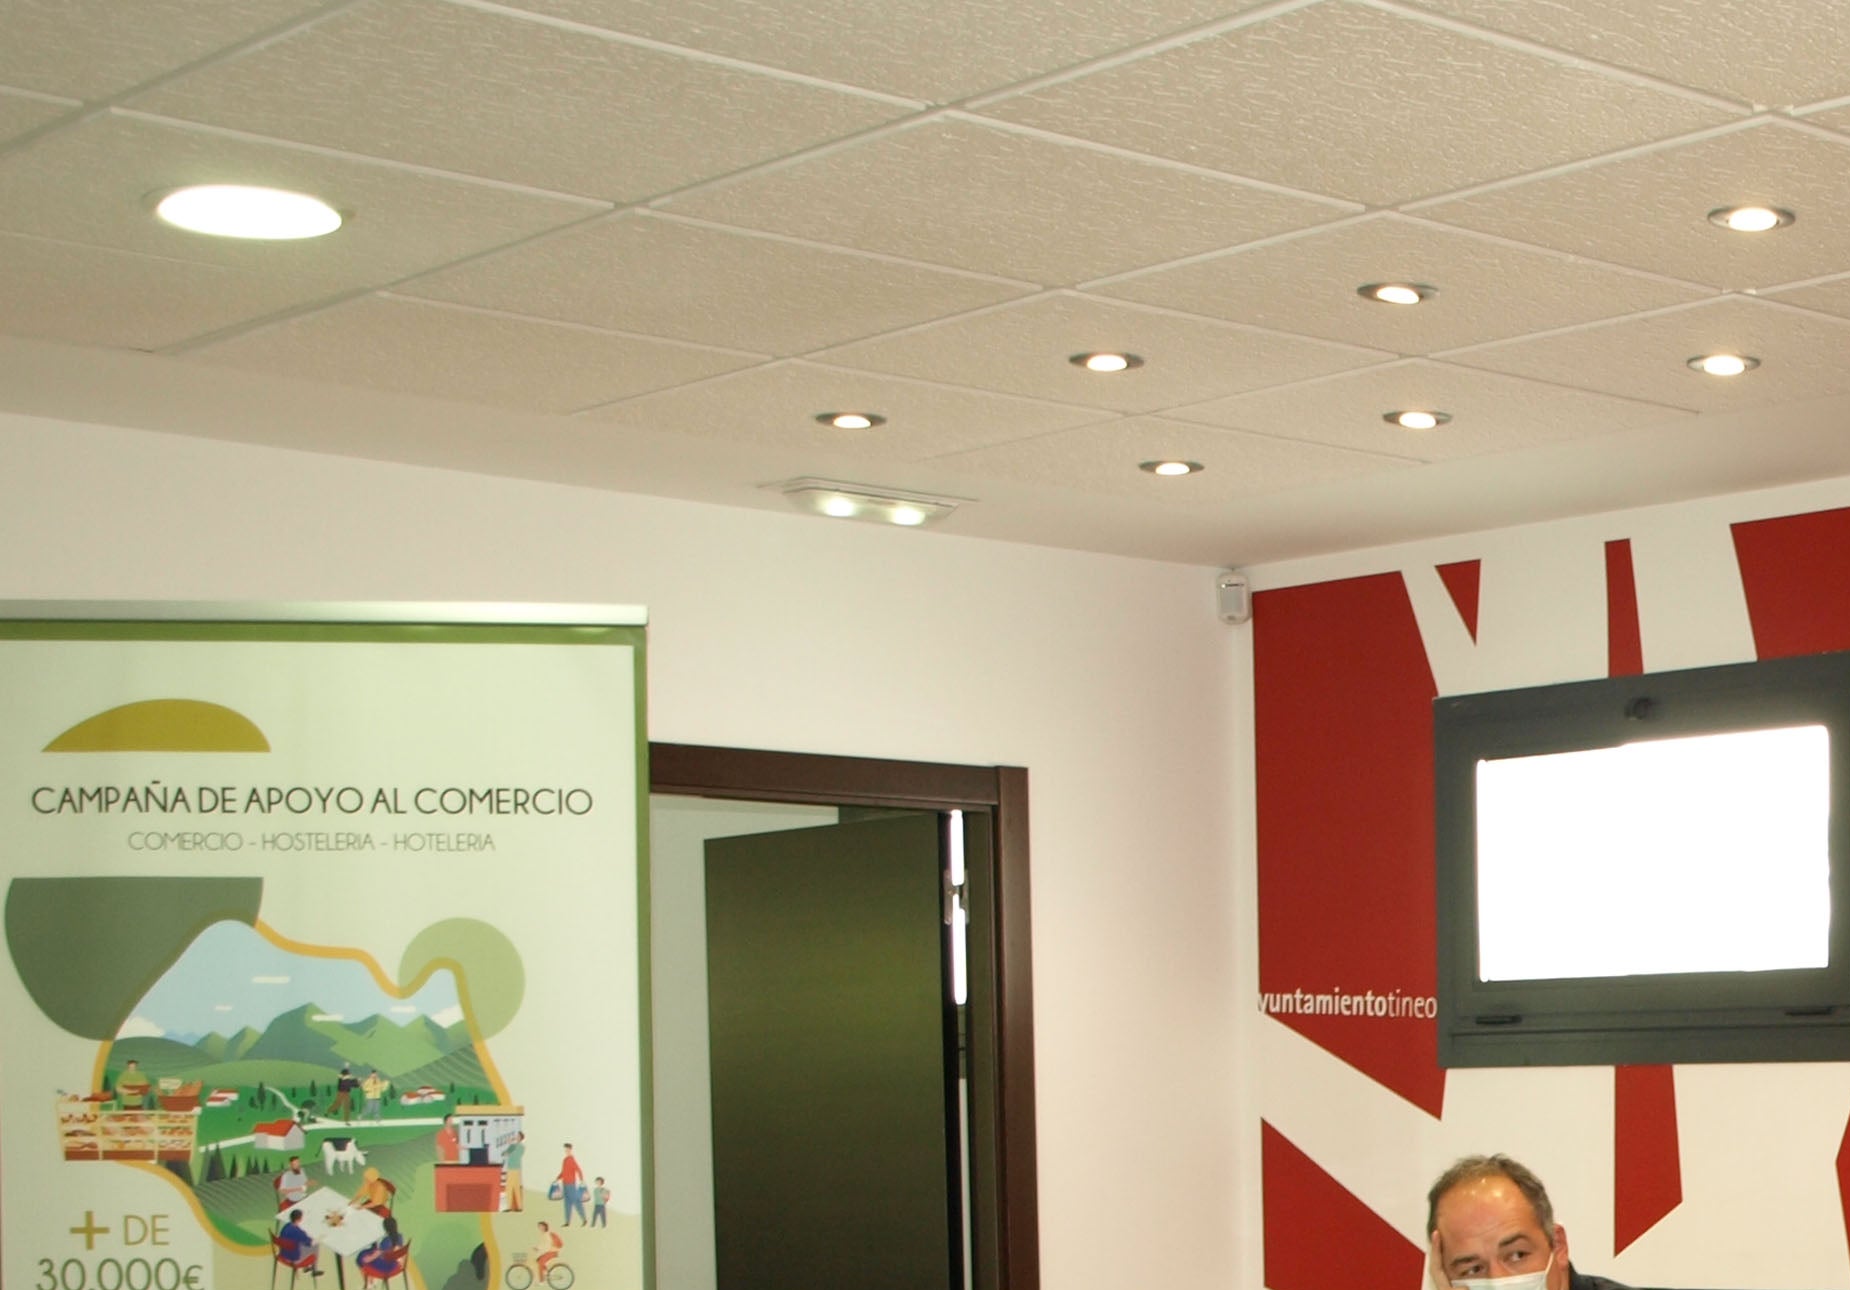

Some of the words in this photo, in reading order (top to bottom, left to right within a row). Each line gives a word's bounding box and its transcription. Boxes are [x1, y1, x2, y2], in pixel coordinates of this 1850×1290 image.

[31, 780, 192, 815] CAMPAÑA
[200, 787, 237, 815] DE
[243, 787, 364, 815] APOYO
[370, 787, 407, 815] AL
[414, 787, 594, 815] COMERCIO
[128, 831, 243, 853] COMERCIO
[262, 831, 376, 853] HOSTELERIA
[393, 831, 496, 853] HOTELERIA
[124, 1214, 170, 1246] DE
